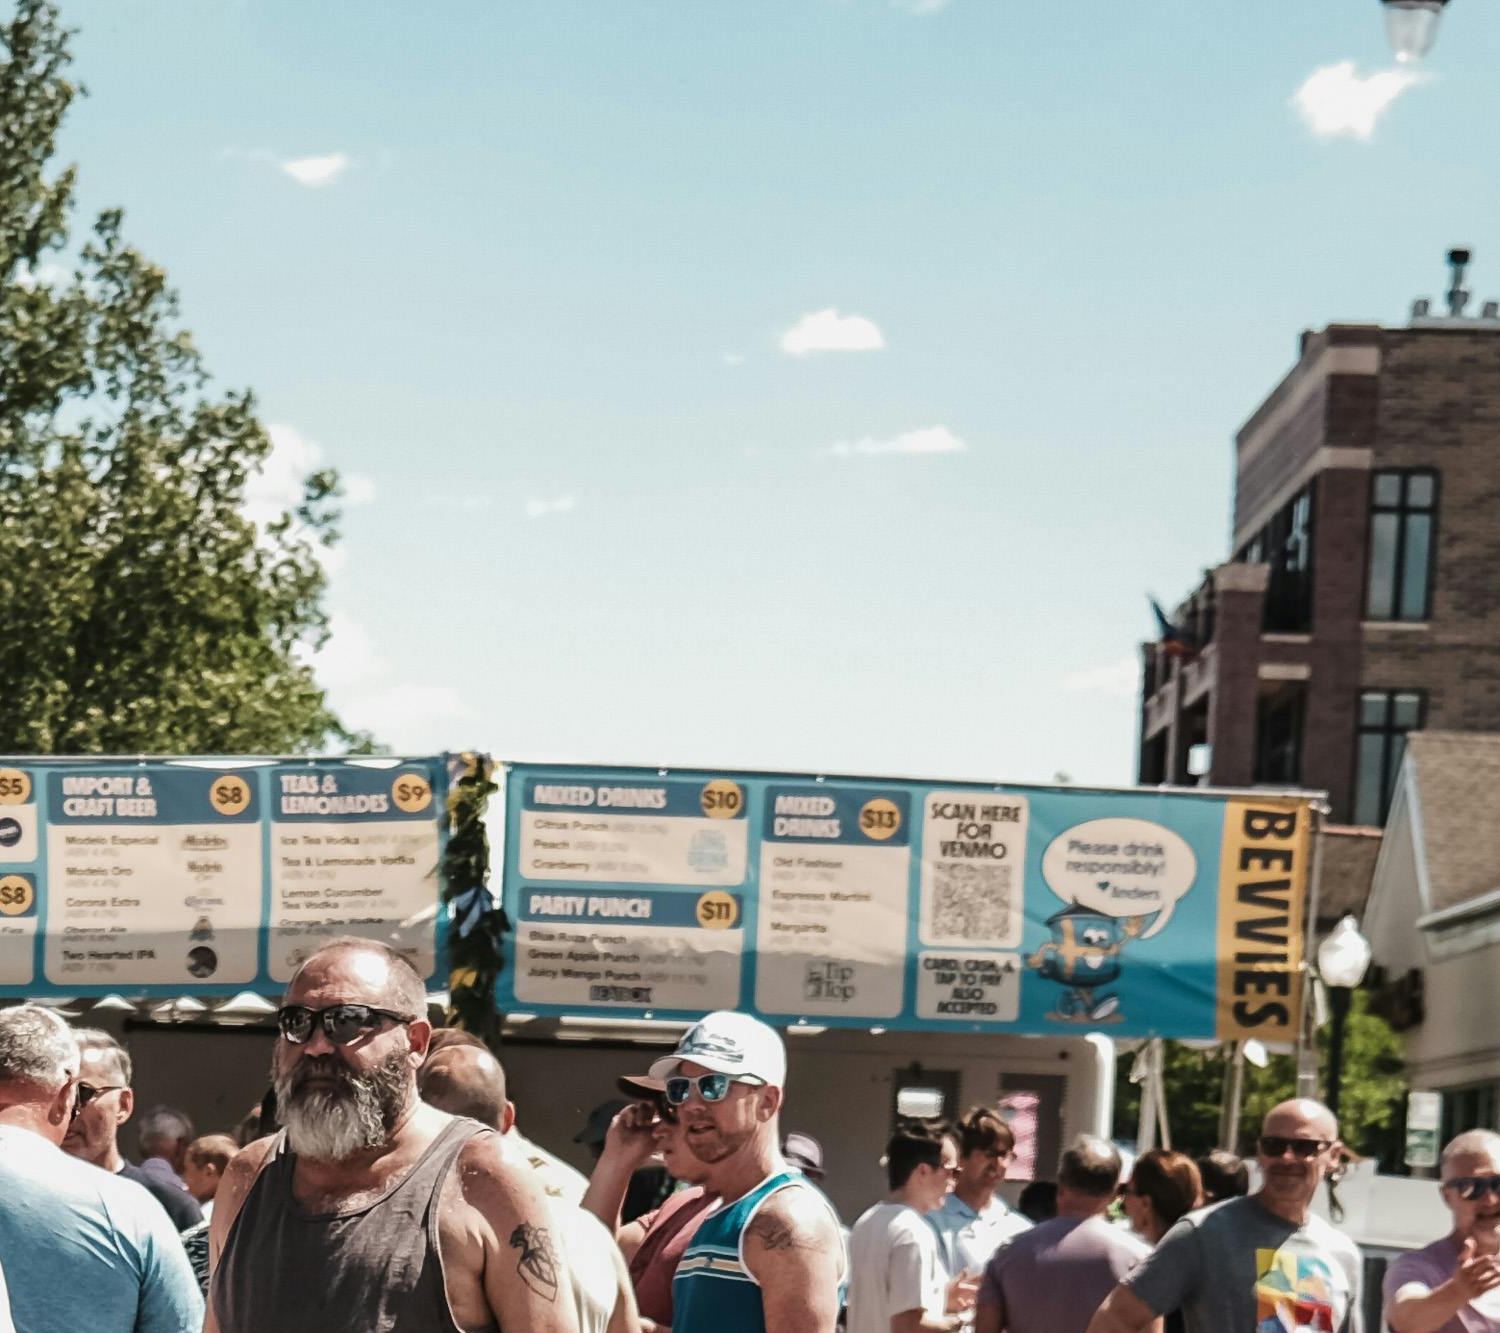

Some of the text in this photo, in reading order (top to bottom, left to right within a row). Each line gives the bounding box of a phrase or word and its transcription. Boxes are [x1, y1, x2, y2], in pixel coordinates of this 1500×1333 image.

[62, 777, 153, 795] IMPORT &
[280, 775, 338, 794] TEAS &
[398, 784, 425, 802] $9
[216, 786, 243, 804] $8
[533, 785, 668, 808] MIXED DRINKS
[702, 790, 739, 809] $10
[281, 795, 389, 814] LEMONADES
[931, 803, 1021, 823] SCAN HERE
[573, 821, 608, 830] Punch
[862, 809, 897, 828] $13
[956, 822, 992, 840] FOR
[65, 836, 159, 846] Modelo Especial
[280, 836, 297, 845] Ice
[302, 836, 321, 845] Tea
[326, 836, 359, 845] Vodka
[533, 839, 569, 849] Peach
[1067, 840, 1164, 856] Please drink
[940, 841, 1007, 859] VENMO
[282, 857, 300, 866] Tea
[316, 857, 375, 866] Lemonade
[532, 859, 590, 871] Cranberry
[112, 867, 133, 876] Oro
[0, 886, 26, 904] $8
[66, 898, 140, 907] Corona Extra
[530, 895, 652, 918] PARTY PUNCH
[702, 900, 731, 920] $11
[1232, 809, 1297, 1028] BEVVIES
[63, 950, 156, 960] Two Hearted IPA
[528, 950, 563, 960] Green
[567, 951, 599, 962] Apple
[603, 952, 640, 962] Punch
[528, 968, 558, 979] Juicy
[562, 969, 601, 981] Mango
[605, 970, 641, 981] Punch
[825, 962, 854, 982] Tip
[825, 981, 857, 1002] Top
[952, 988, 984, 1000] ALSO
